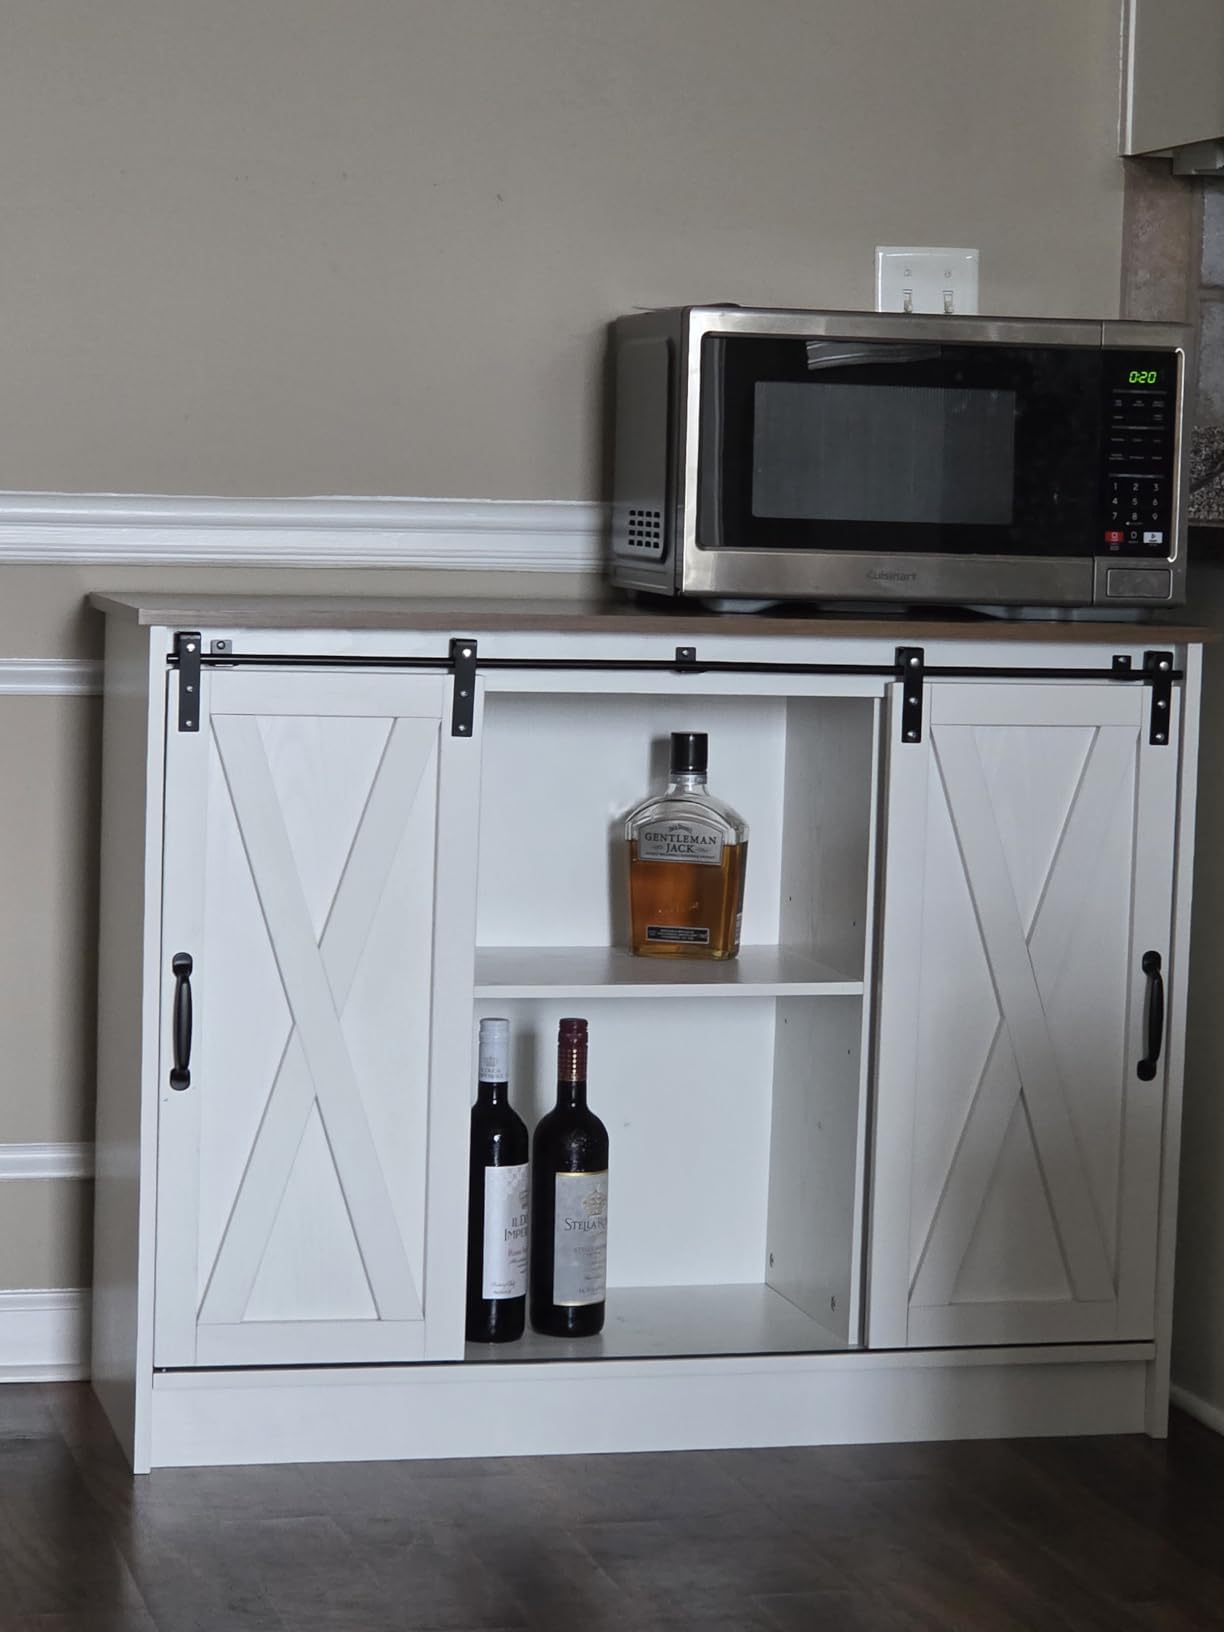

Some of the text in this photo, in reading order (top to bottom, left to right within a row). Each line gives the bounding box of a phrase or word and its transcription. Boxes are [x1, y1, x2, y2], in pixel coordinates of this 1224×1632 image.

[1129, 370, 1158, 385] 0:20
[1113, 482, 1159, 492] 1 2 3
[1112, 497, 1158, 506] 4 5 6
[1112, 511, 1158, 521] 7 8 9
[865, 569, 917, 582] Cuisinart
[644, 832, 718, 845] GENTLEMAN
[666, 842, 696, 854] JACK
[564, 1217, 597, 1232] STELLA
